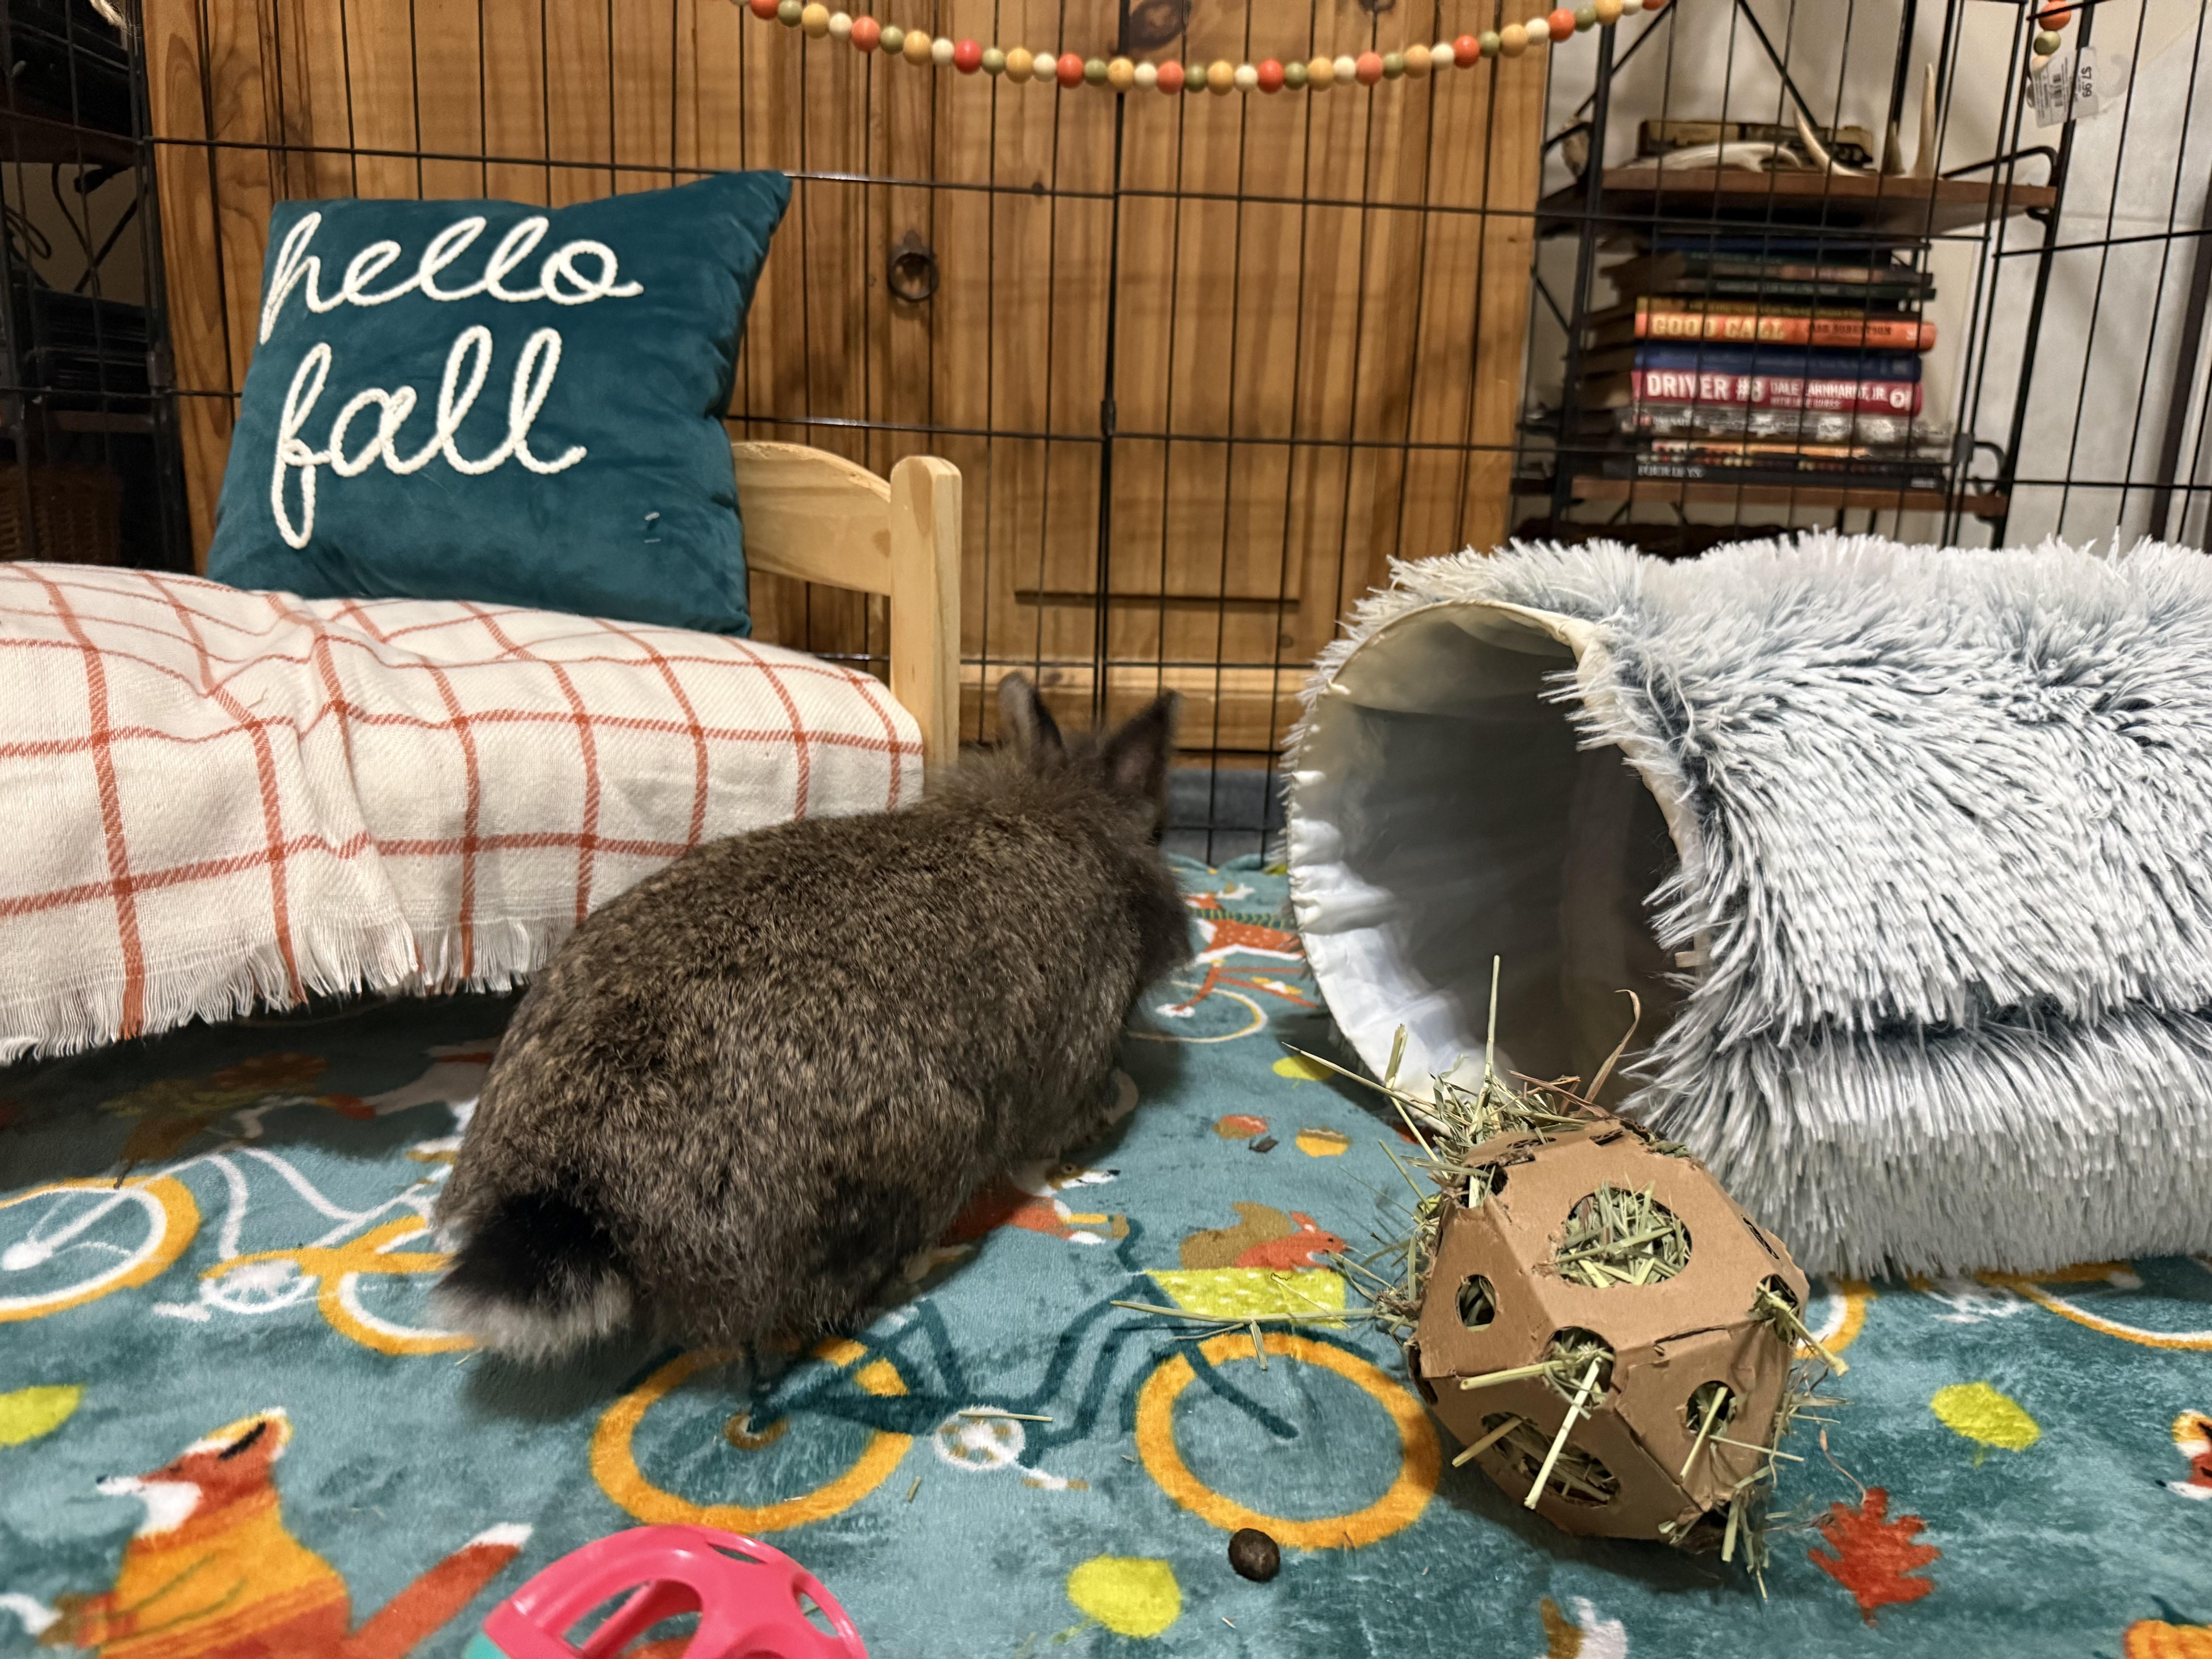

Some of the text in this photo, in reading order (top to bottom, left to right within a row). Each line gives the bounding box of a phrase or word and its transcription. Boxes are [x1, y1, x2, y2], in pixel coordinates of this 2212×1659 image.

[2081, 66, 2092, 98] $7.99
[259, 211, 644, 345] hello
[1651, 314, 1716, 336] GOOD
[1646, 372, 1730, 400] DRIVER
[1771, 380, 1799, 395] DALE
[271, 325, 587, 549] fall
